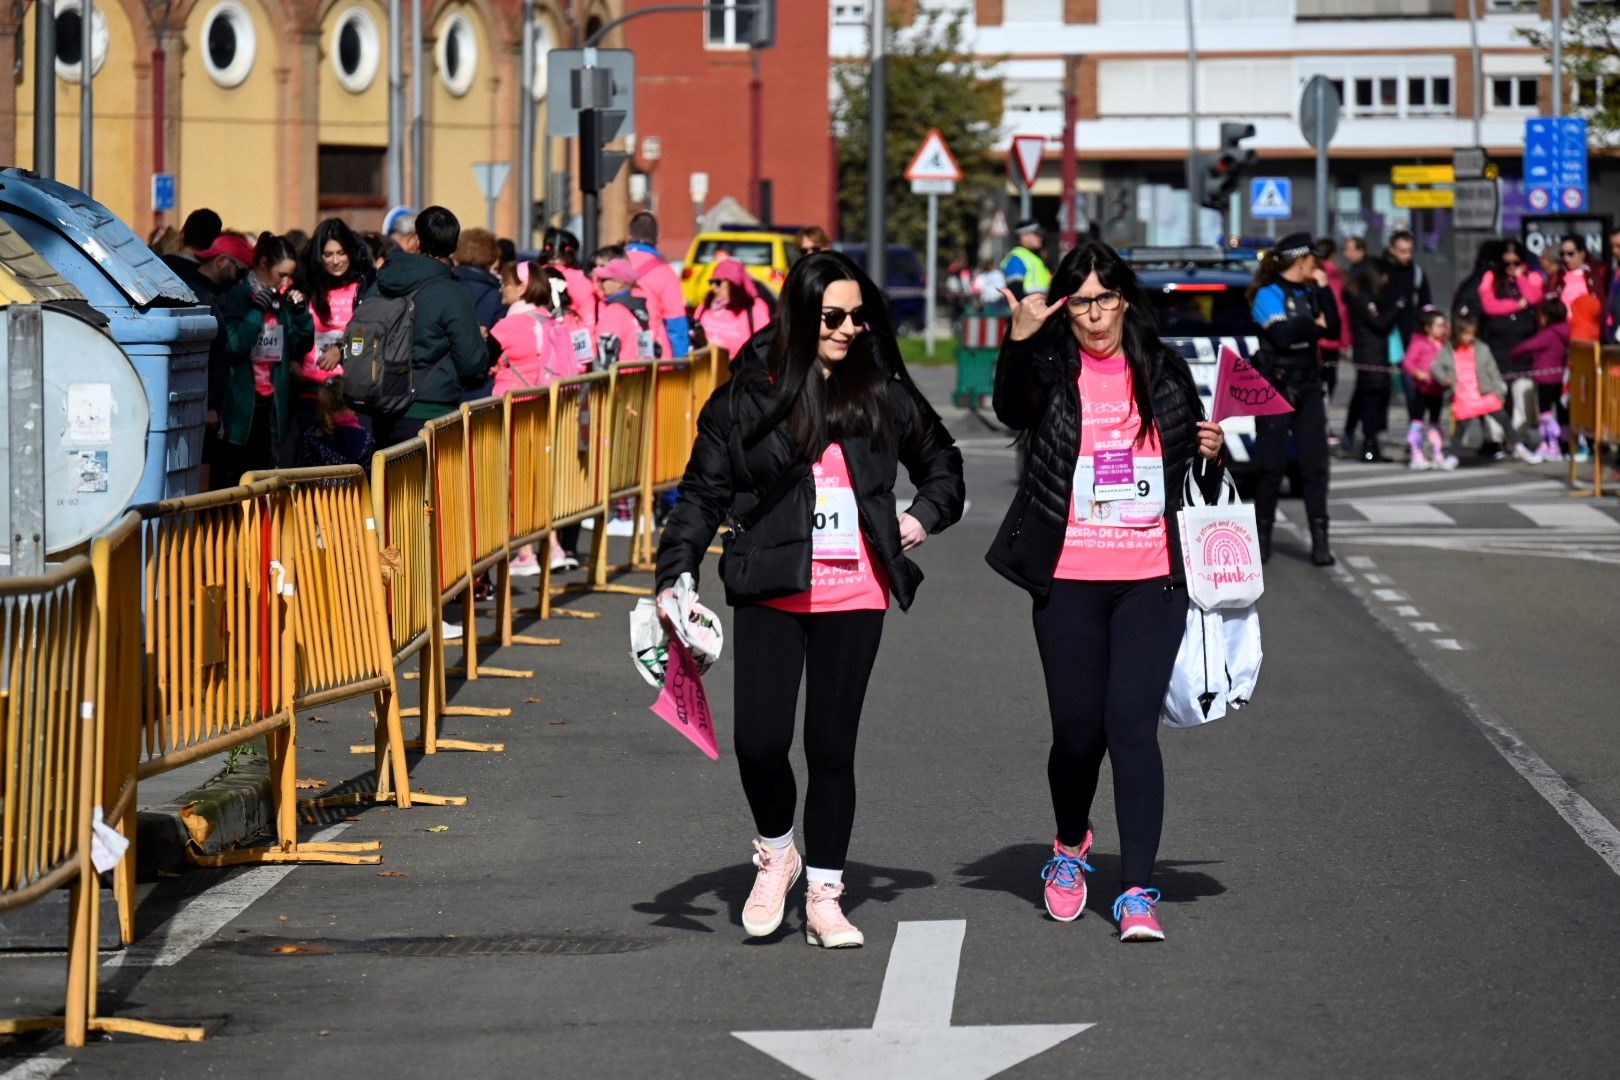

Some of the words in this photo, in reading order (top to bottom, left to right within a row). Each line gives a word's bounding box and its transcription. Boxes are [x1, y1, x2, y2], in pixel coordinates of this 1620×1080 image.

[258, 336, 278, 347] 2041
[1099, 528, 1113, 538] DE
[1115, 528, 1128, 539] LA
[1213, 566, 1245, 590] pink
